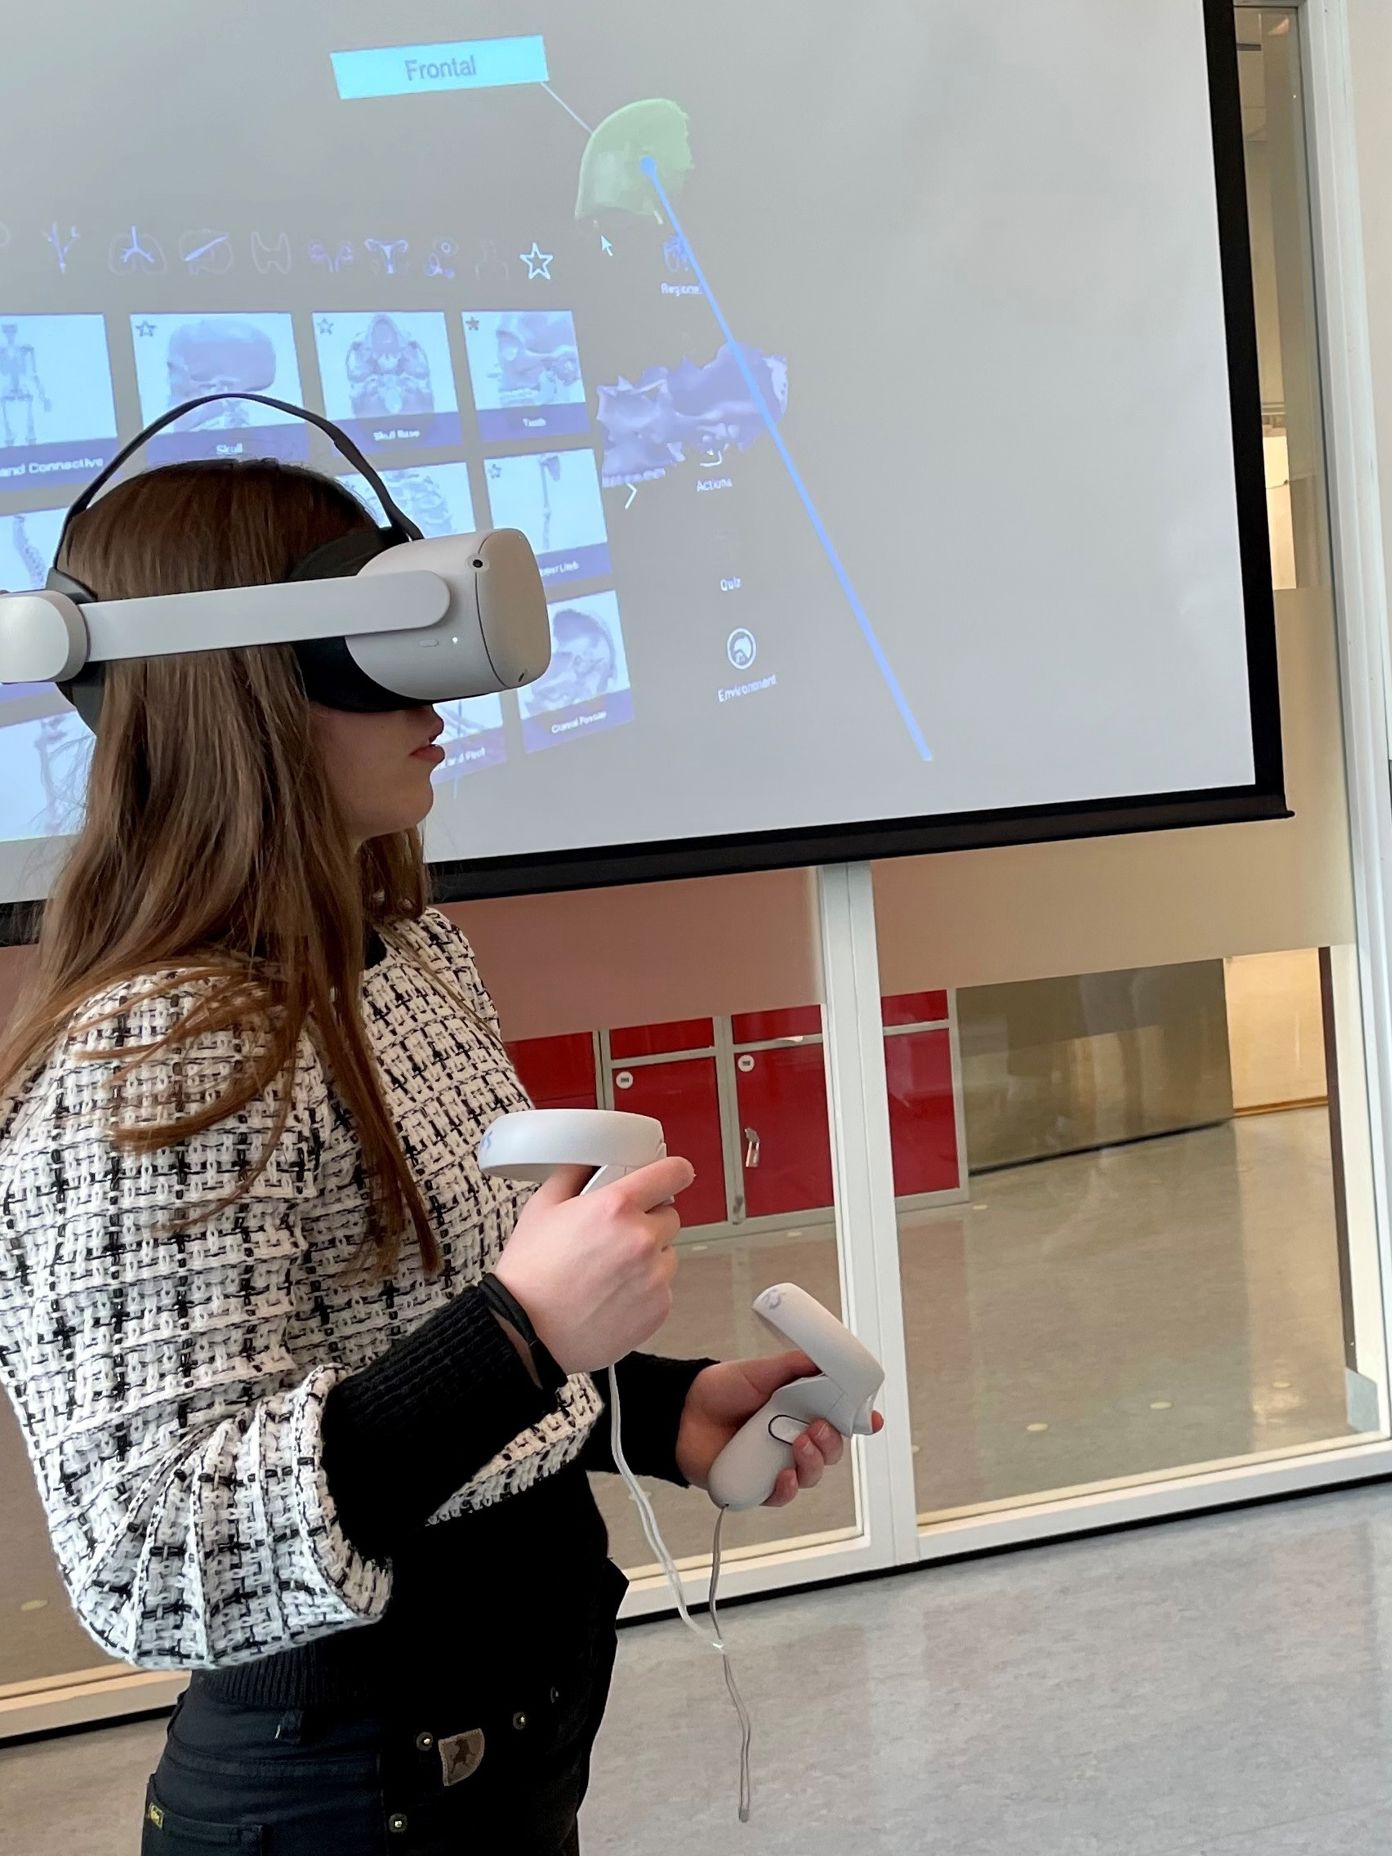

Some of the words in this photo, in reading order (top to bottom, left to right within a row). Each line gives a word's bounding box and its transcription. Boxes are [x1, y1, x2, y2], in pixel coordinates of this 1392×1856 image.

[404, 54, 477, 81] Frontal
[216, 443, 244, 456] Skull
[28, 457, 104, 474] Connective
[696, 478, 733, 492] Actions
[720, 576, 741, 591] Quiz
[717, 674, 777, 703] Environment
